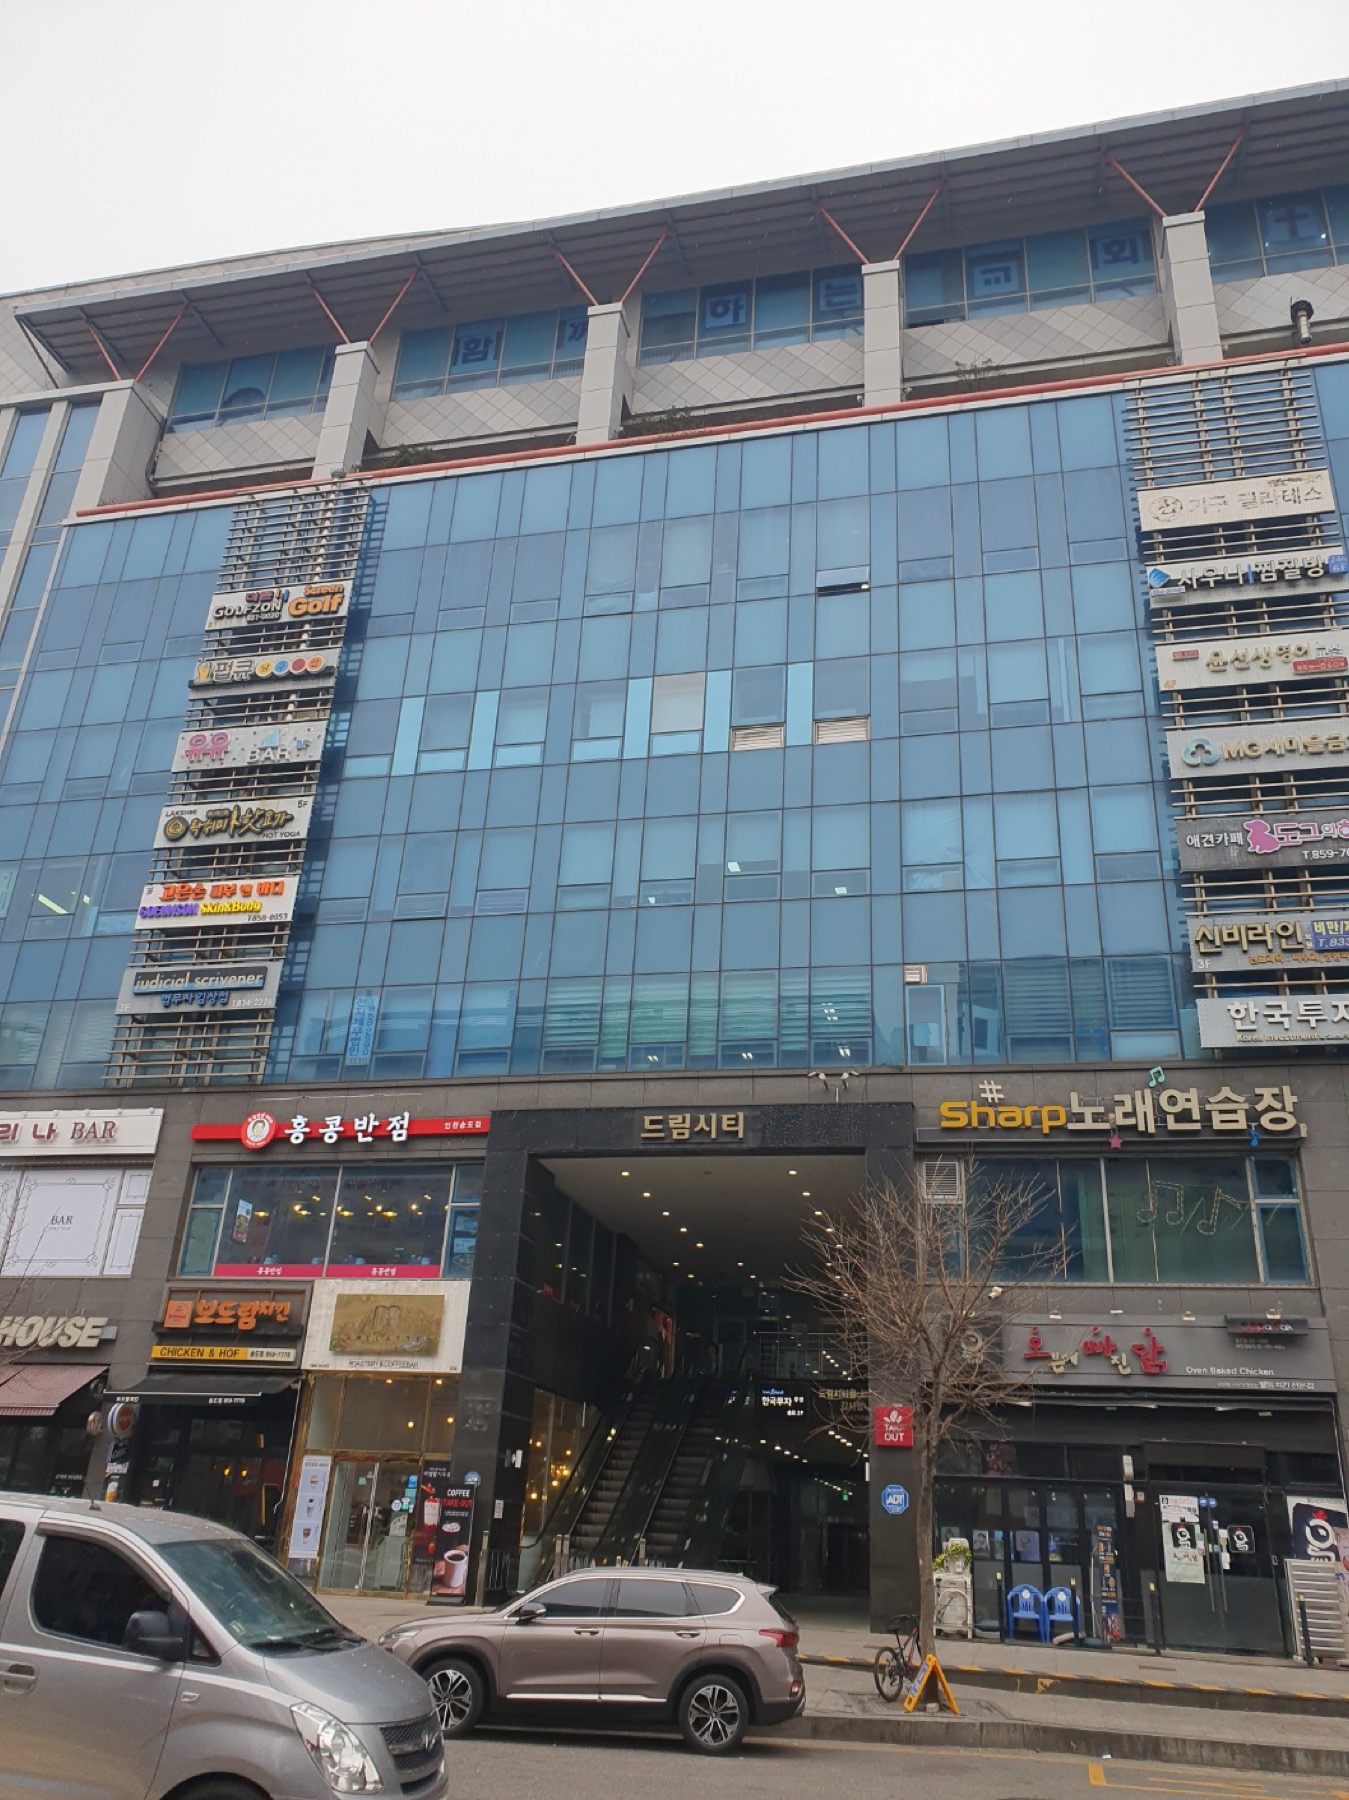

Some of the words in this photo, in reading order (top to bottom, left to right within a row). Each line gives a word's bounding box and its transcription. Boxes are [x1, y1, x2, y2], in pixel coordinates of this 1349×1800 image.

[1177, 563, 1245, 590] 사우나
[1254, 555, 1326, 583] 찜질방
[304, 584, 345, 598] Screen
[288, 594, 344, 617] Golf
[246, 748, 290, 764] BAR
[297, 800, 309, 809] 5F
[280, 830, 300, 838] YOGA
[1186, 832, 1244, 848] 애견카페
[159, 882, 207, 902] 고은손
[209, 883, 238, 898] 피부
[256, 880, 285, 896] 바디
[199, 899, 263, 916] Skin&Body
[1194, 921, 1306, 954] 신비라인
[1197, 958, 1212, 969] 3F
[133, 972, 189, 991] judicial
[194, 972, 264, 988] scrivener
[118, 1003, 131, 1012] 3F
[160, 992, 195, 1008] 법무사
[939, 1100, 1067, 1134] Sharp
[1066, 1085, 1299, 1134] 노래연습장
[70, 1120, 119, 1141] BAR
[284, 1111, 410, 1144] 홍콩반점
[640, 1111, 745, 1141] 드림시티
[50, 1215, 74, 1225] BAR
[0, 1315, 109, 1348] HOUSE
[160, 1346, 205, 1357] CHICKEN
[208, 1348, 215, 1358] &
[218, 1349, 240, 1358] HOF
[1185, 1365, 1208, 1375] Oven
[1209, 1366, 1237, 1376] Baked
[1239, 1367, 1275, 1376] Chicken
[884, 1433, 905, 1442] OUT
[446, 1488, 471, 1498] COFFEE
[885, 1494, 905, 1506] ADT
